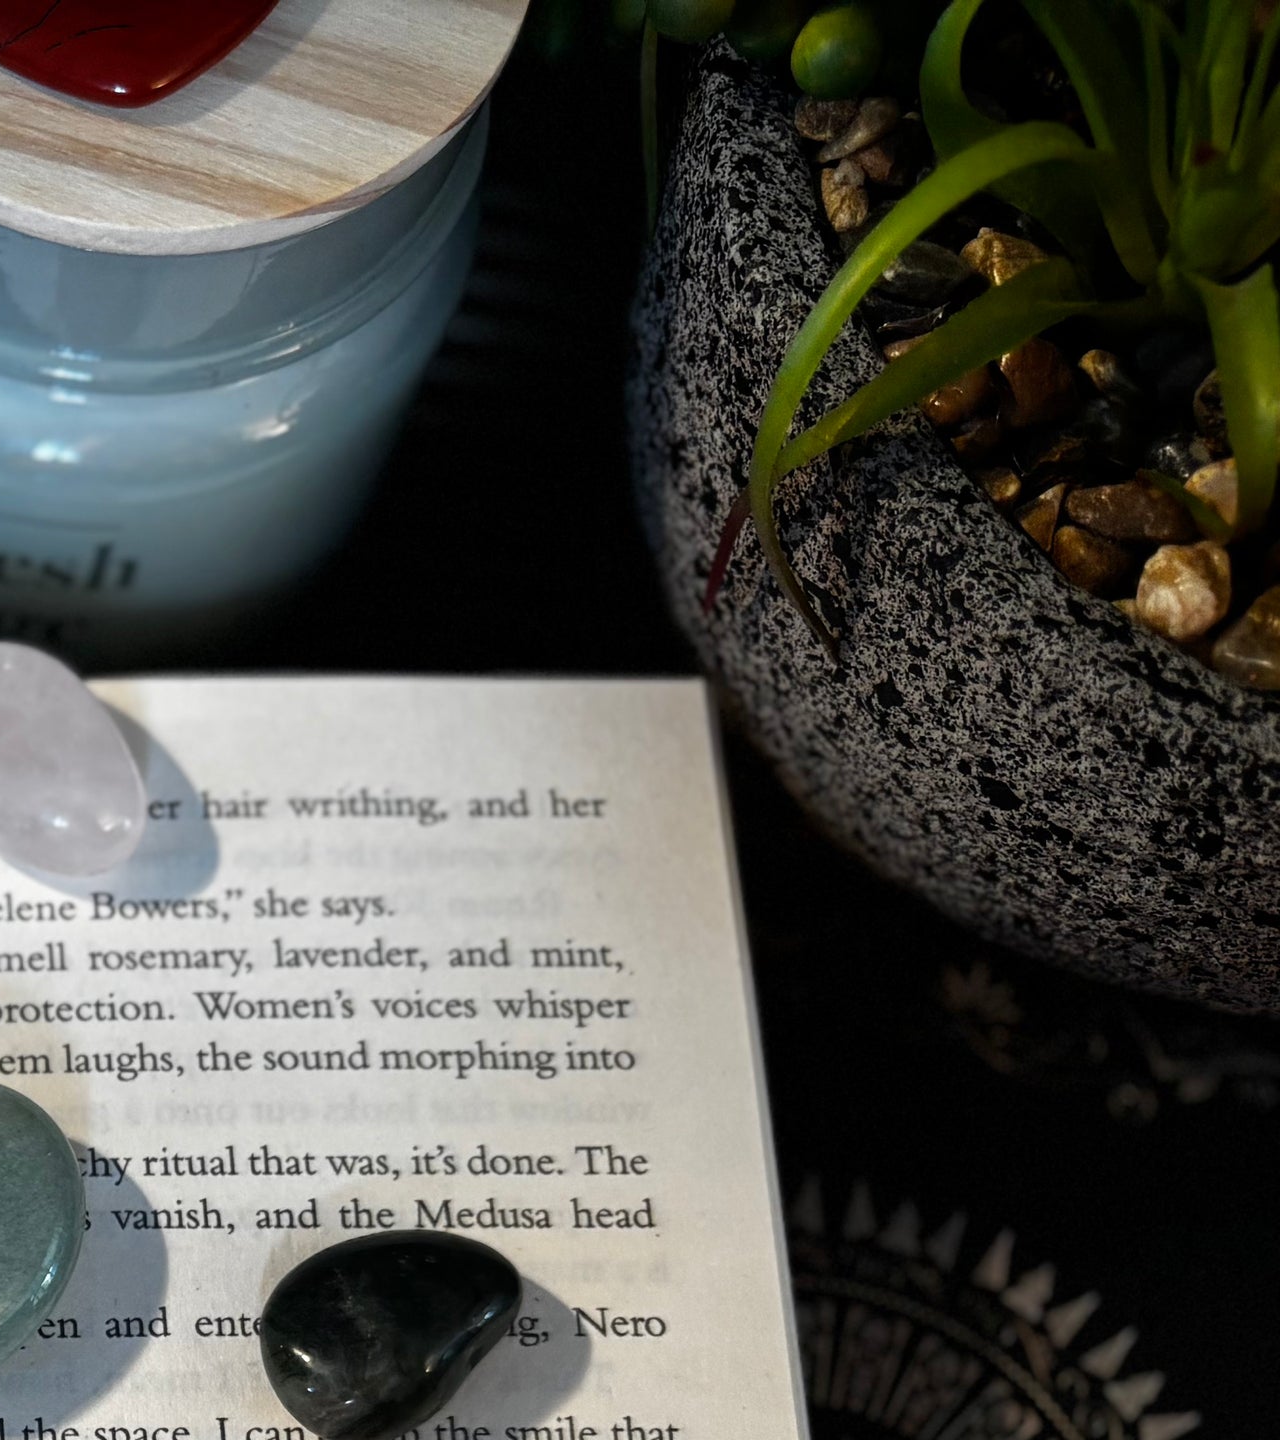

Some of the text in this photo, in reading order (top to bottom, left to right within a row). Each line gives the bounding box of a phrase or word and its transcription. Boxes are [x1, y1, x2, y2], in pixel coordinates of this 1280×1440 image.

[87, 886, 245, 924] Bowers,”
[251, 886, 311, 920] she
[319, 894, 397, 927] says.
[86, 947, 256, 979] rosemary,
[271, 935, 431, 974] lavender,
[446, 936, 515, 970] and
[528, 937, 626, 975] mint,
[109, 1196, 658, 1236] vanish, and the Medusa head
